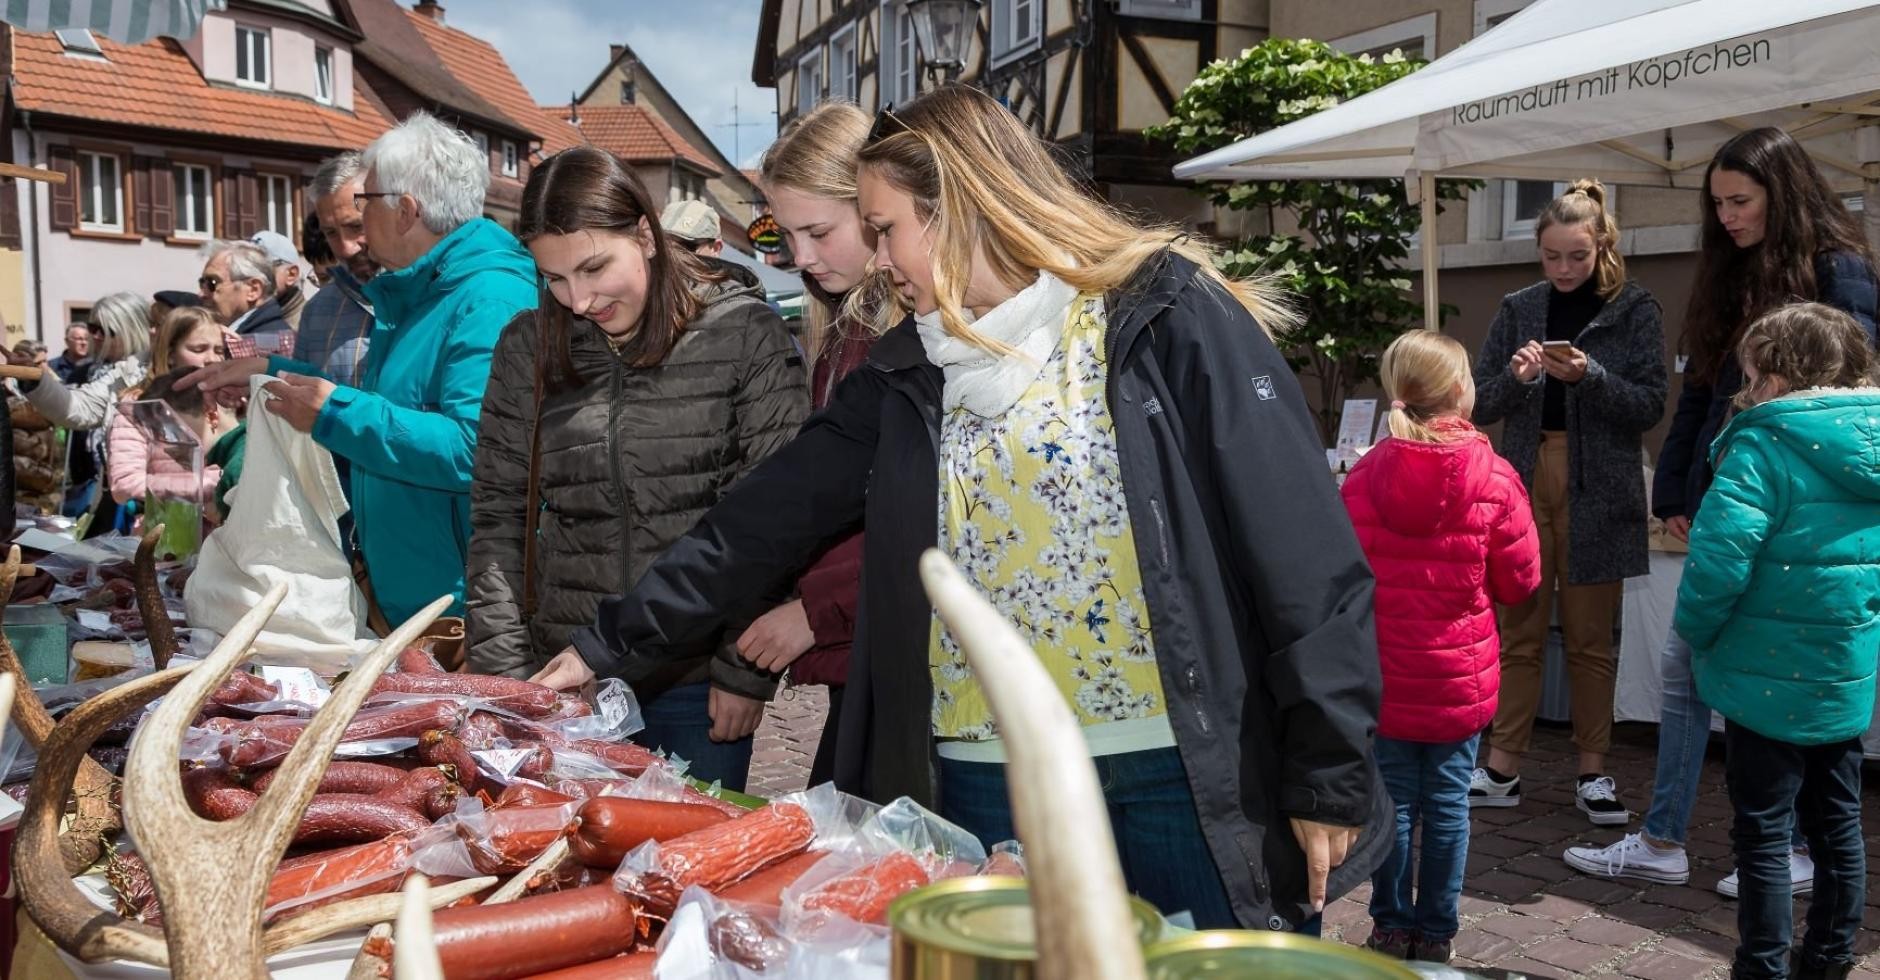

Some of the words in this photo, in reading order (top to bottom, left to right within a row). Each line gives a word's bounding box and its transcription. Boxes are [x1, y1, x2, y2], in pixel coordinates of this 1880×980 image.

[1453, 79, 1570, 125] Raumduft
[1577, 66, 1619, 100] mit
[1628, 39, 1770, 88] Köpfchen
